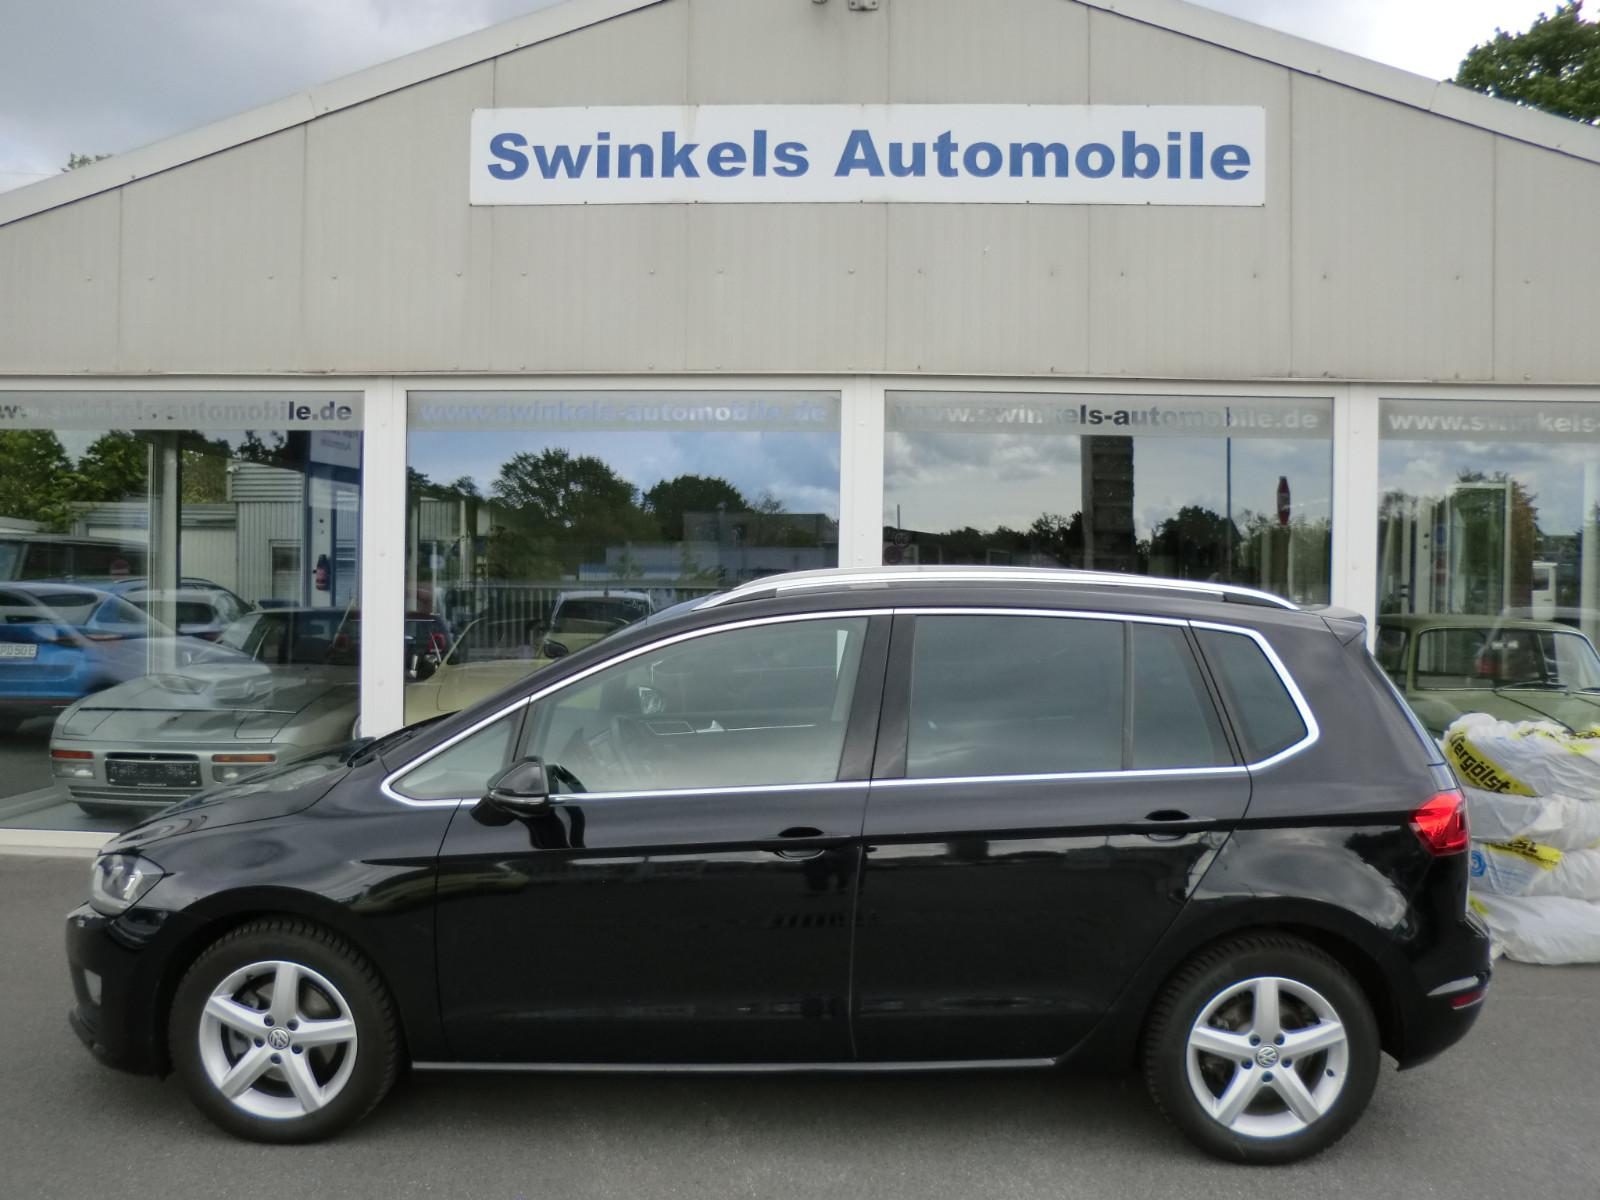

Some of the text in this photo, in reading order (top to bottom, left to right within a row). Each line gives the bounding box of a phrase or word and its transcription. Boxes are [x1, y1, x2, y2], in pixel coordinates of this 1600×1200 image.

[486, 129, 1251, 180] Swinkels Automobile
[1388, 412, 1600, 433] www.swinkels
